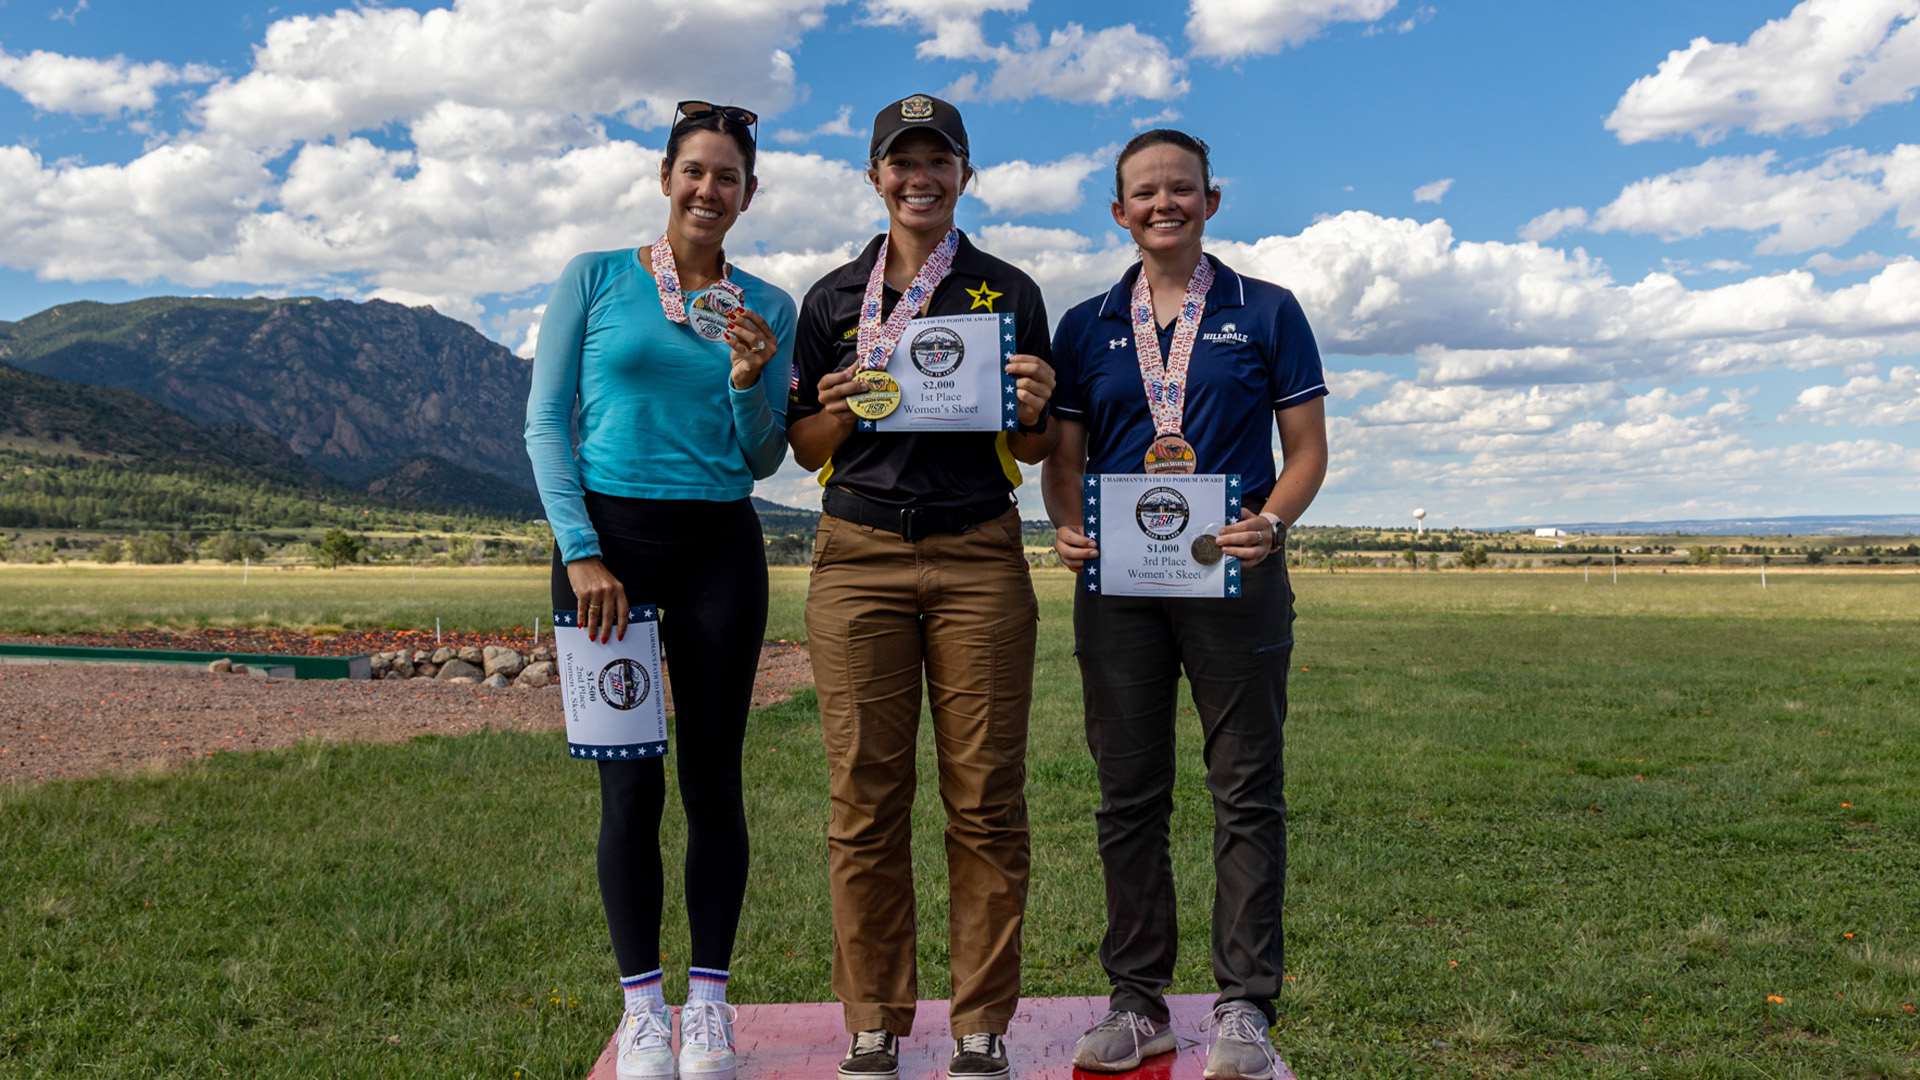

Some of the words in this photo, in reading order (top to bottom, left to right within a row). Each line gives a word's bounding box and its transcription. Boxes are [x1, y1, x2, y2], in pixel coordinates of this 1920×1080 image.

[909, 286, 925, 301] USA
[1185, 302, 1199, 320] USA
[1174, 330, 1185, 349] FALL
[1202, 332, 1248, 343] HILLSDALE
[870, 346, 883, 366] USA
[1136, 333, 1151, 372] SELECTION
[1148, 350, 1159, 368] FALL
[1177, 329, 1194, 371] SELECTION
[922, 380, 955, 391] $2,000
[1152, 382, 1163, 403] USA
[1168, 382, 1179, 404] USA
[920, 393, 934, 401] 1st
[936, 392, 962, 401] Place
[904, 404, 950, 414] Women's
[951, 404, 979, 414] Skeet
[1147, 543, 1179, 555] $1,000
[1143, 557, 1159, 566] 3rd
[1161, 556, 1187, 566] Place
[1127, 569, 1173, 579] Women's
[1176, 570, 1201, 579] Skeet
[566, 652, 576, 695] Women's
[576, 665, 585, 682] 2nd
[587, 671, 597, 702] $1,500
[578, 686, 586, 709] Place
